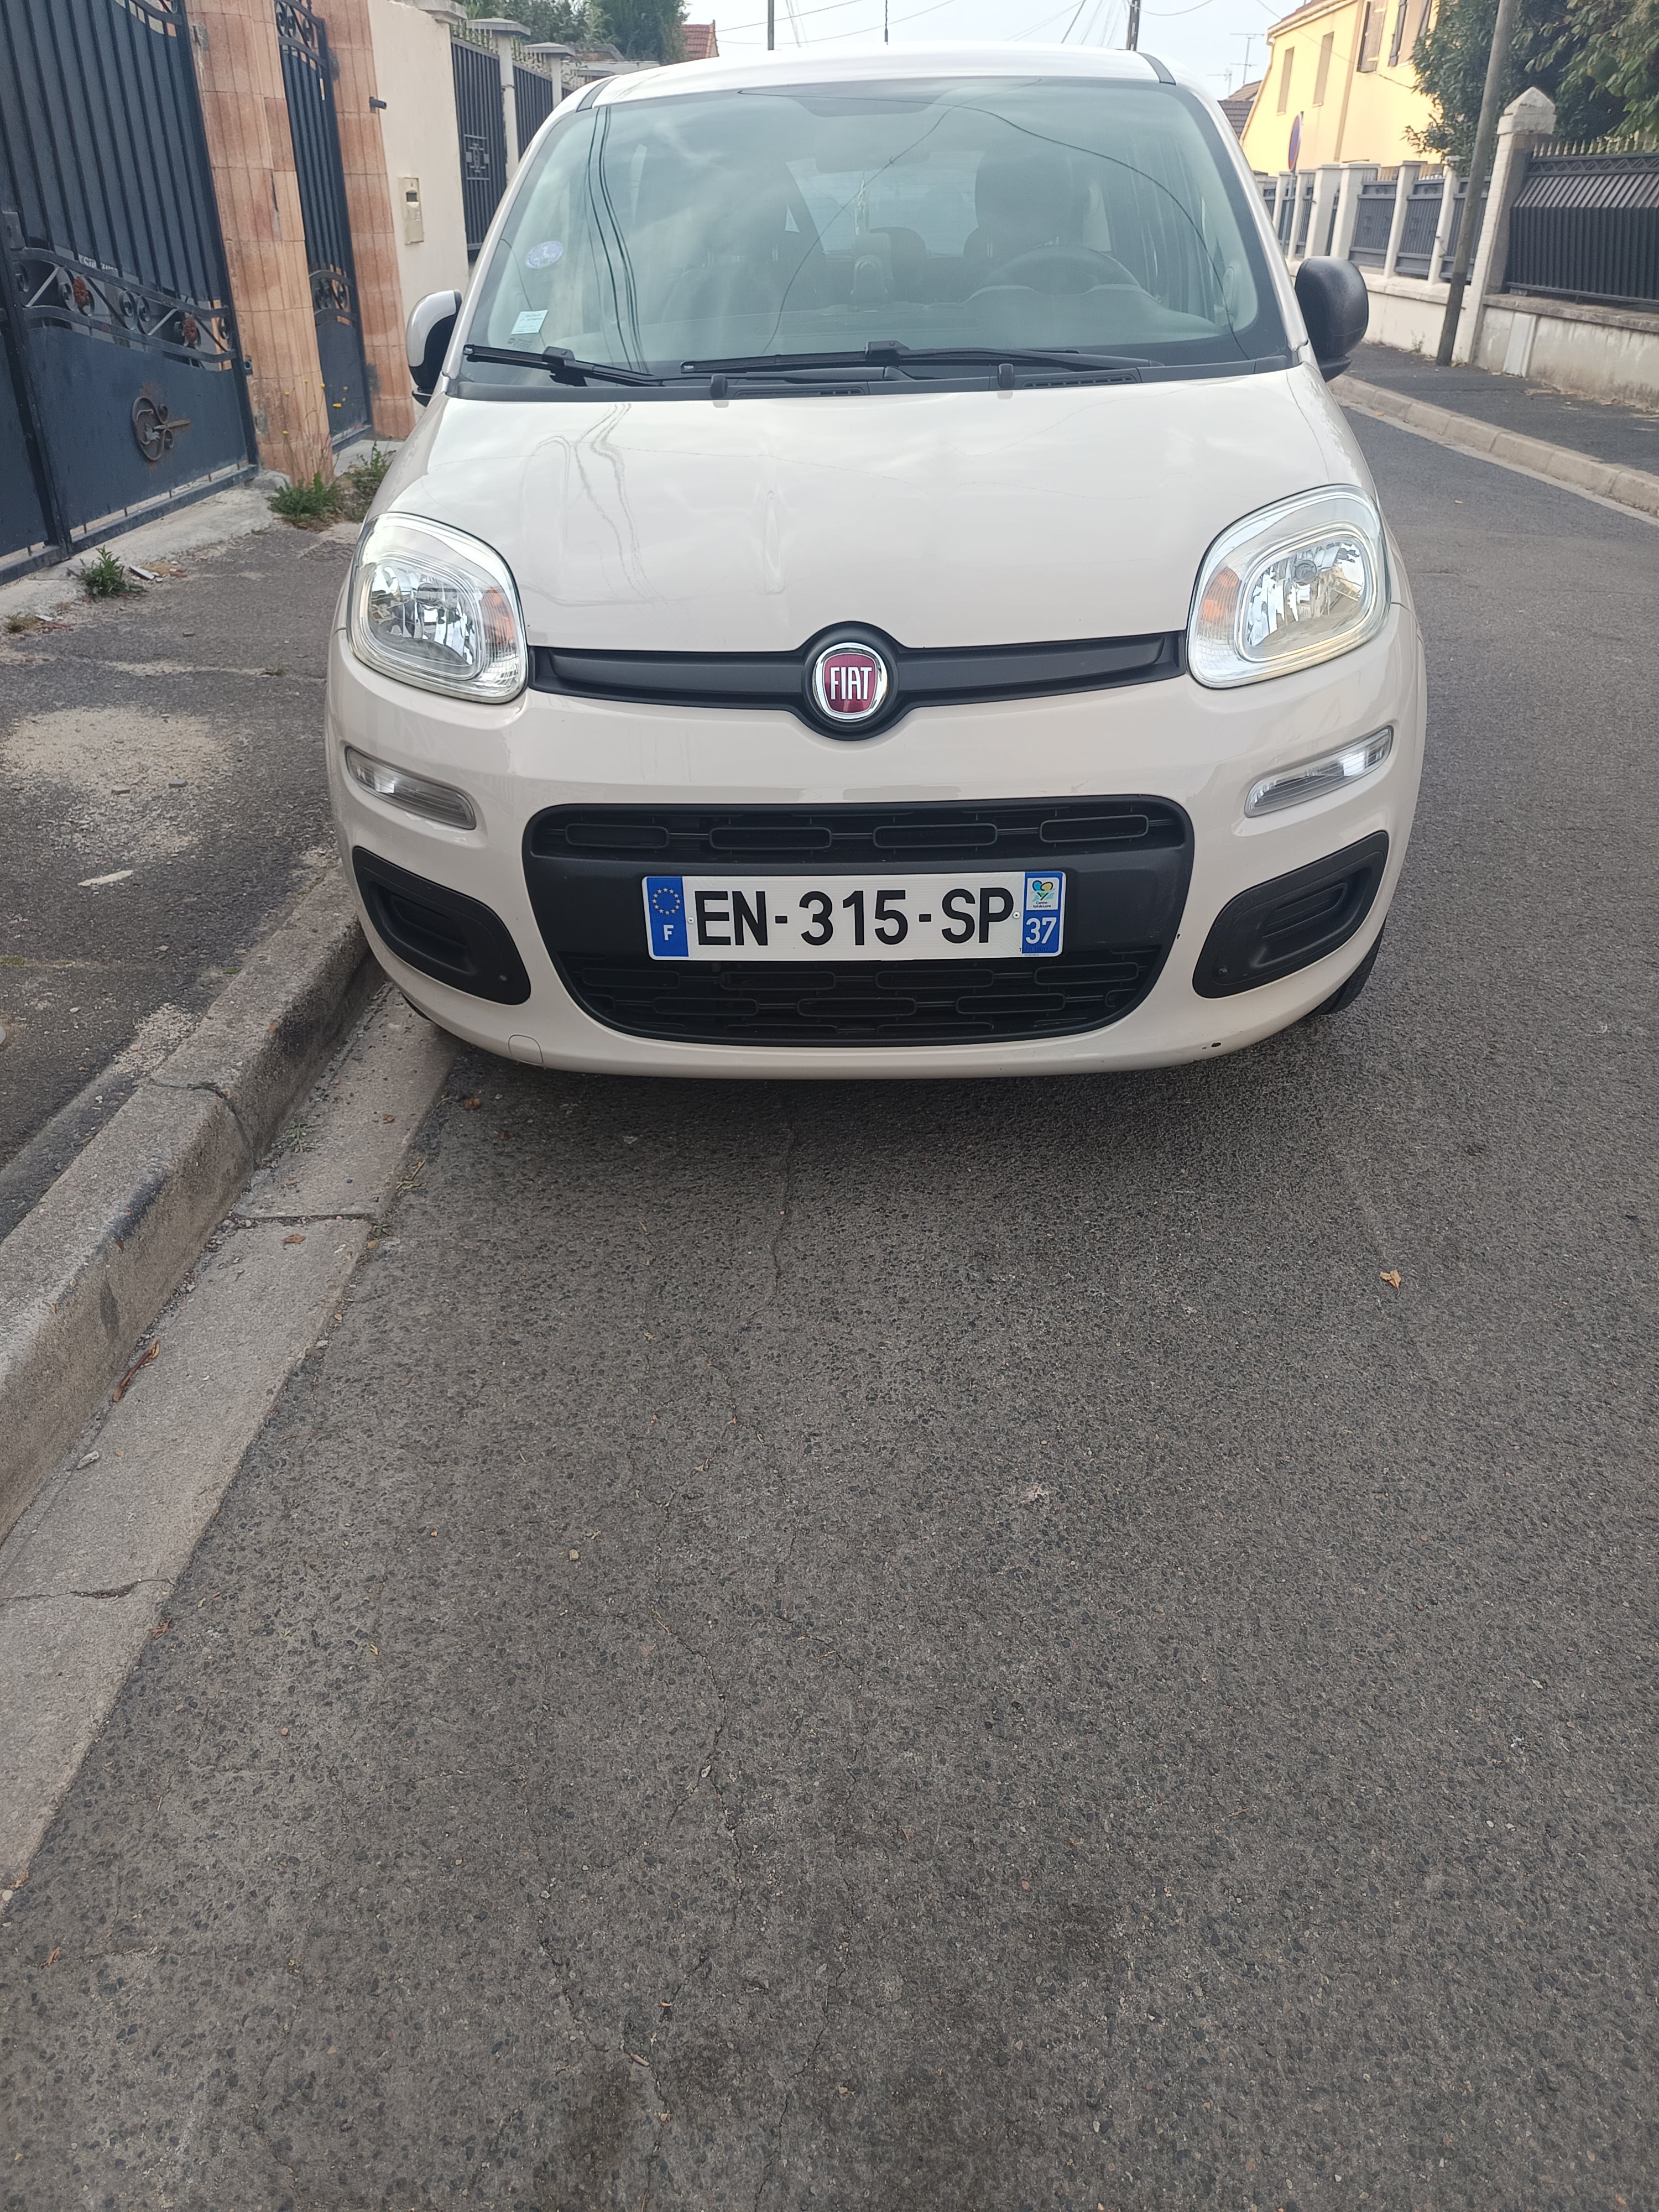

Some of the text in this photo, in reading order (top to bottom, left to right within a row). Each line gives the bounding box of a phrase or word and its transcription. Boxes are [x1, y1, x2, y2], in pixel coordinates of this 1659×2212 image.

[830, 667, 872, 700] FIAT
[695, 888, 1014, 946] EN-315-SP
[1026, 917, 1057, 944] 37
[664, 925, 674, 940] F
